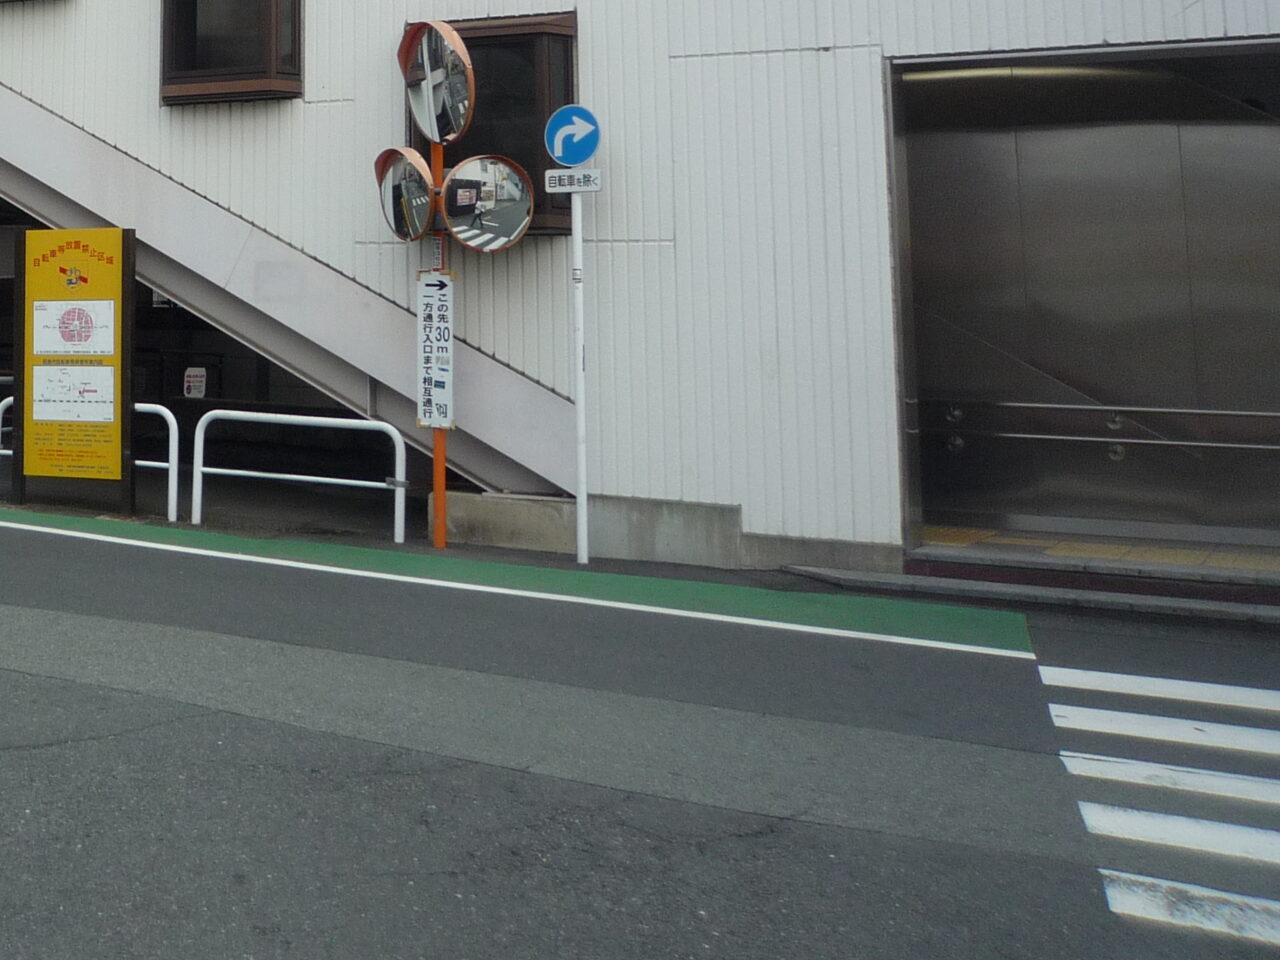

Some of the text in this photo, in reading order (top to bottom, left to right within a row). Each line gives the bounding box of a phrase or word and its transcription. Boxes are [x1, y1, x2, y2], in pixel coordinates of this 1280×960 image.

[548, 173, 598, 188] 自転車を除く
[422, 295, 434, 419] 一方通行入口まで相互通行
